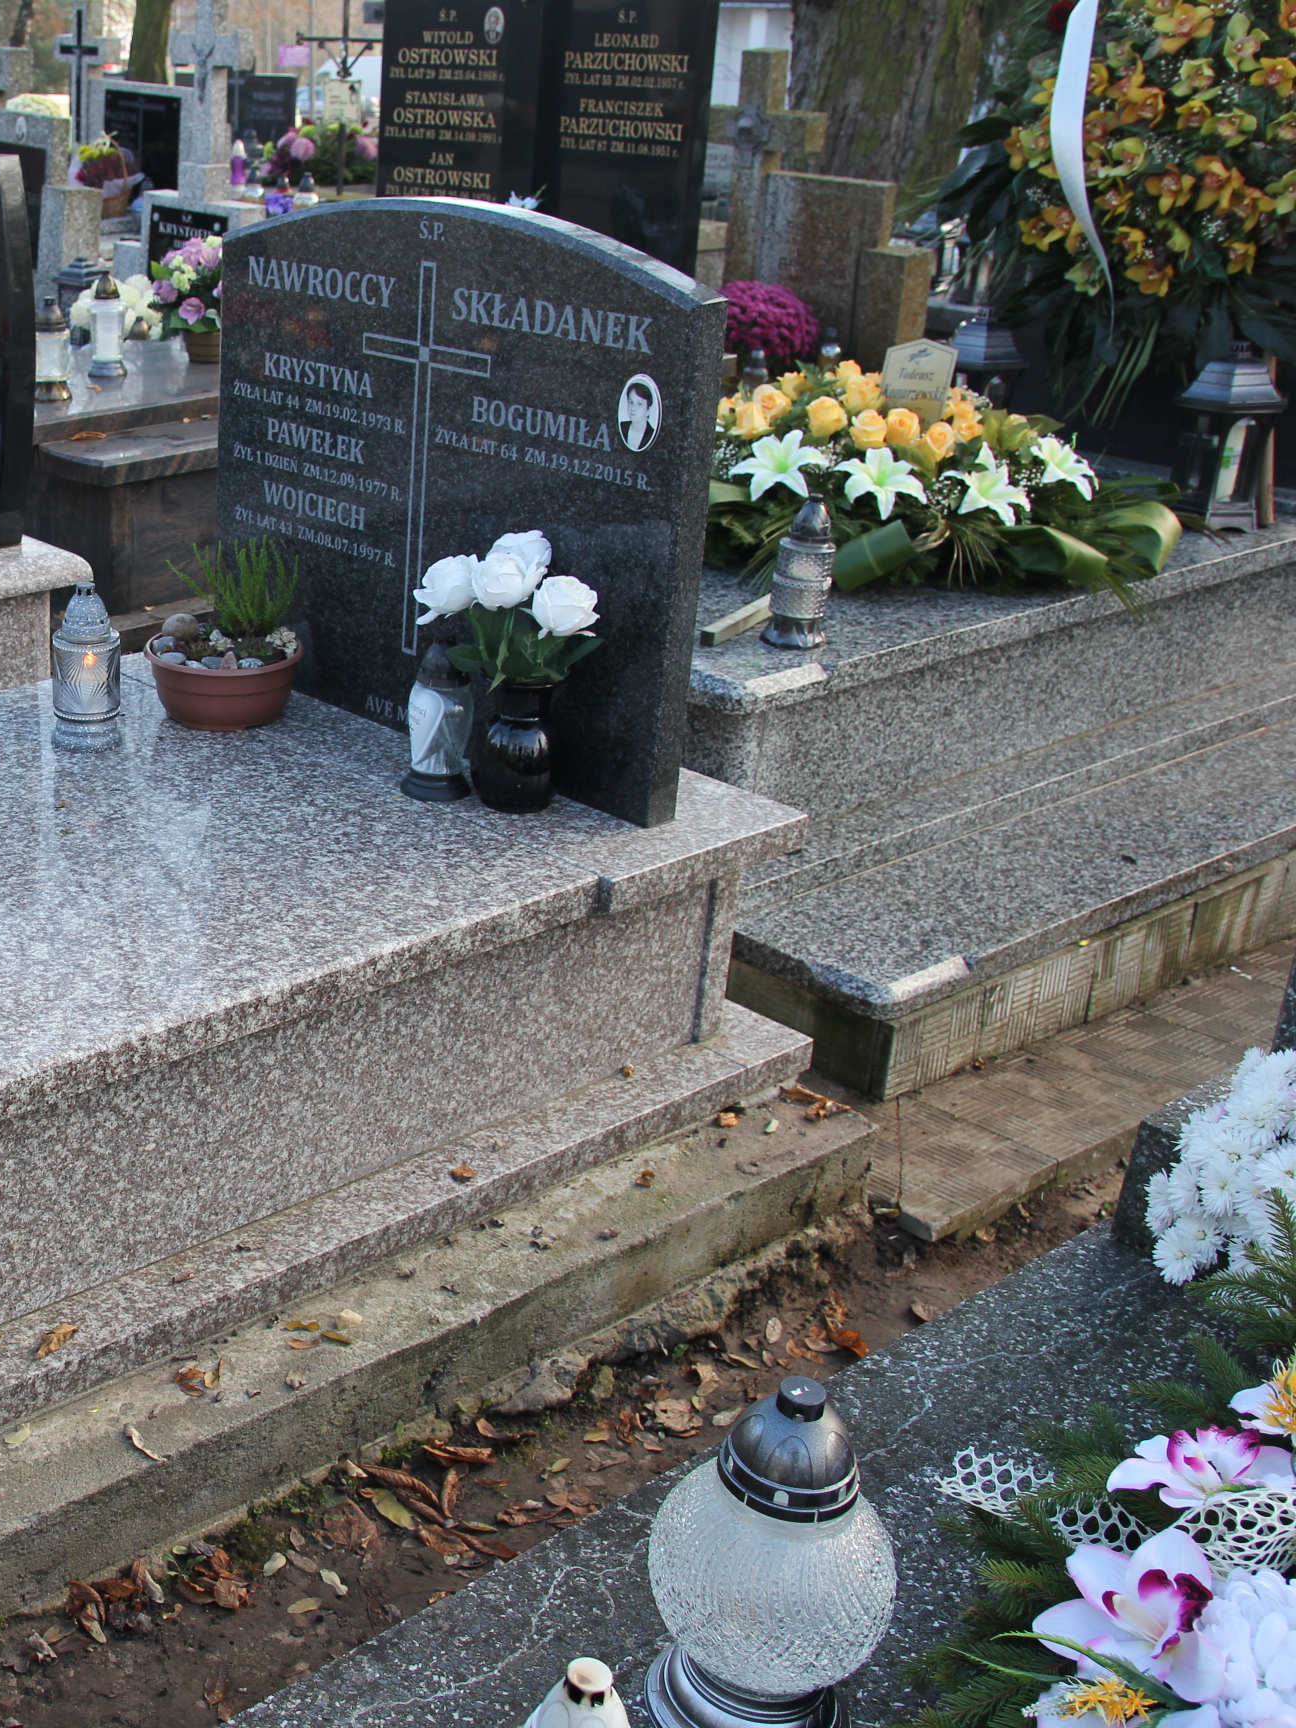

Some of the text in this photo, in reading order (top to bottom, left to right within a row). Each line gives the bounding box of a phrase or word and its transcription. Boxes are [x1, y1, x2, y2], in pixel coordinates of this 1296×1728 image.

[423, 30, 474, 45] WITOLD
[594, 33, 659, 48] LEONARD
[398, 48, 498, 66] OSTROWSKI
[564, 51, 689, 73] PARZUCHOWSKI
[408, 67, 424, 79] LAT
[583, 73, 600, 85] LAT
[405, 91, 485, 107] STANISŁAWA
[579, 98, 664, 117] FRANCISZEK
[393, 107, 496, 128] OSTROWSKA
[559, 116, 683, 141] PARZUCHOWSKI
[408, 128, 425, 139] LAT
[580, 138, 597, 150] LAT
[429, 152, 455, 166] JAN
[393, 166, 491, 189] OSTROWSKI
[247, 255, 396, 308] NAWROCCY
[452, 286, 653, 354] SKŁADANEK
[264, 352, 373, 399] KRYSTYNA
[233, 379, 406, 435] ŻYŁA LAT 44 ZM.19.02.1973 R.
[471, 395, 611, 452] BOGUMIŁA
[267, 417, 365, 465] PAWEŁEK
[435, 425, 652, 491] ŻYŁA LAT 64 ZM.19.12.2015 R.
[233, 442, 402, 502] ŻYŁ 1 DZIEŃ ZM.12.09.1977 R.
[263, 479, 366, 531] WOJCIECH
[235, 504, 255, 525] ŻYŁ
[257, 512, 277, 531] LAT
[278, 519, 293, 536] 43
[384, 552, 396, 567] R.
[365, 695, 394, 719] AVE
